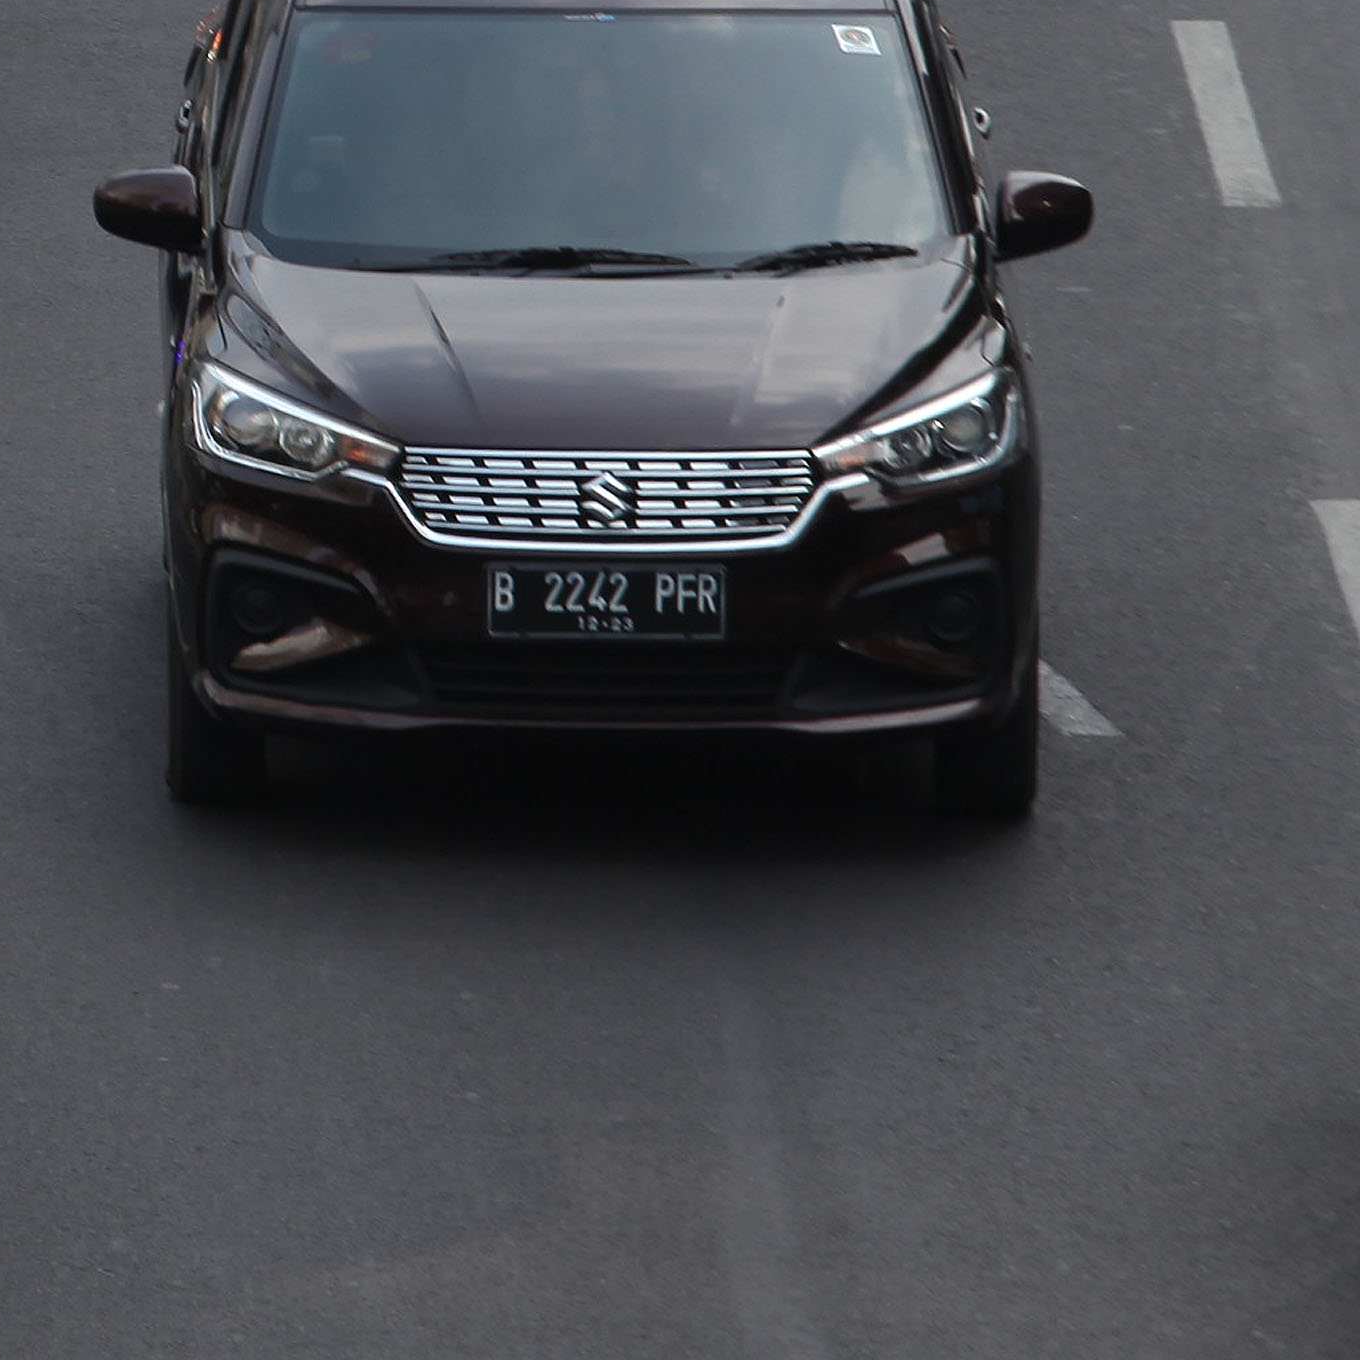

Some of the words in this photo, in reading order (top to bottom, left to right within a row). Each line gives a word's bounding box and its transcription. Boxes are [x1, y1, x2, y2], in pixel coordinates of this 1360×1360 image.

[495, 572, 514, 611] B
[545, 572, 628, 612] 2242
[656, 573, 718, 614] PFR
